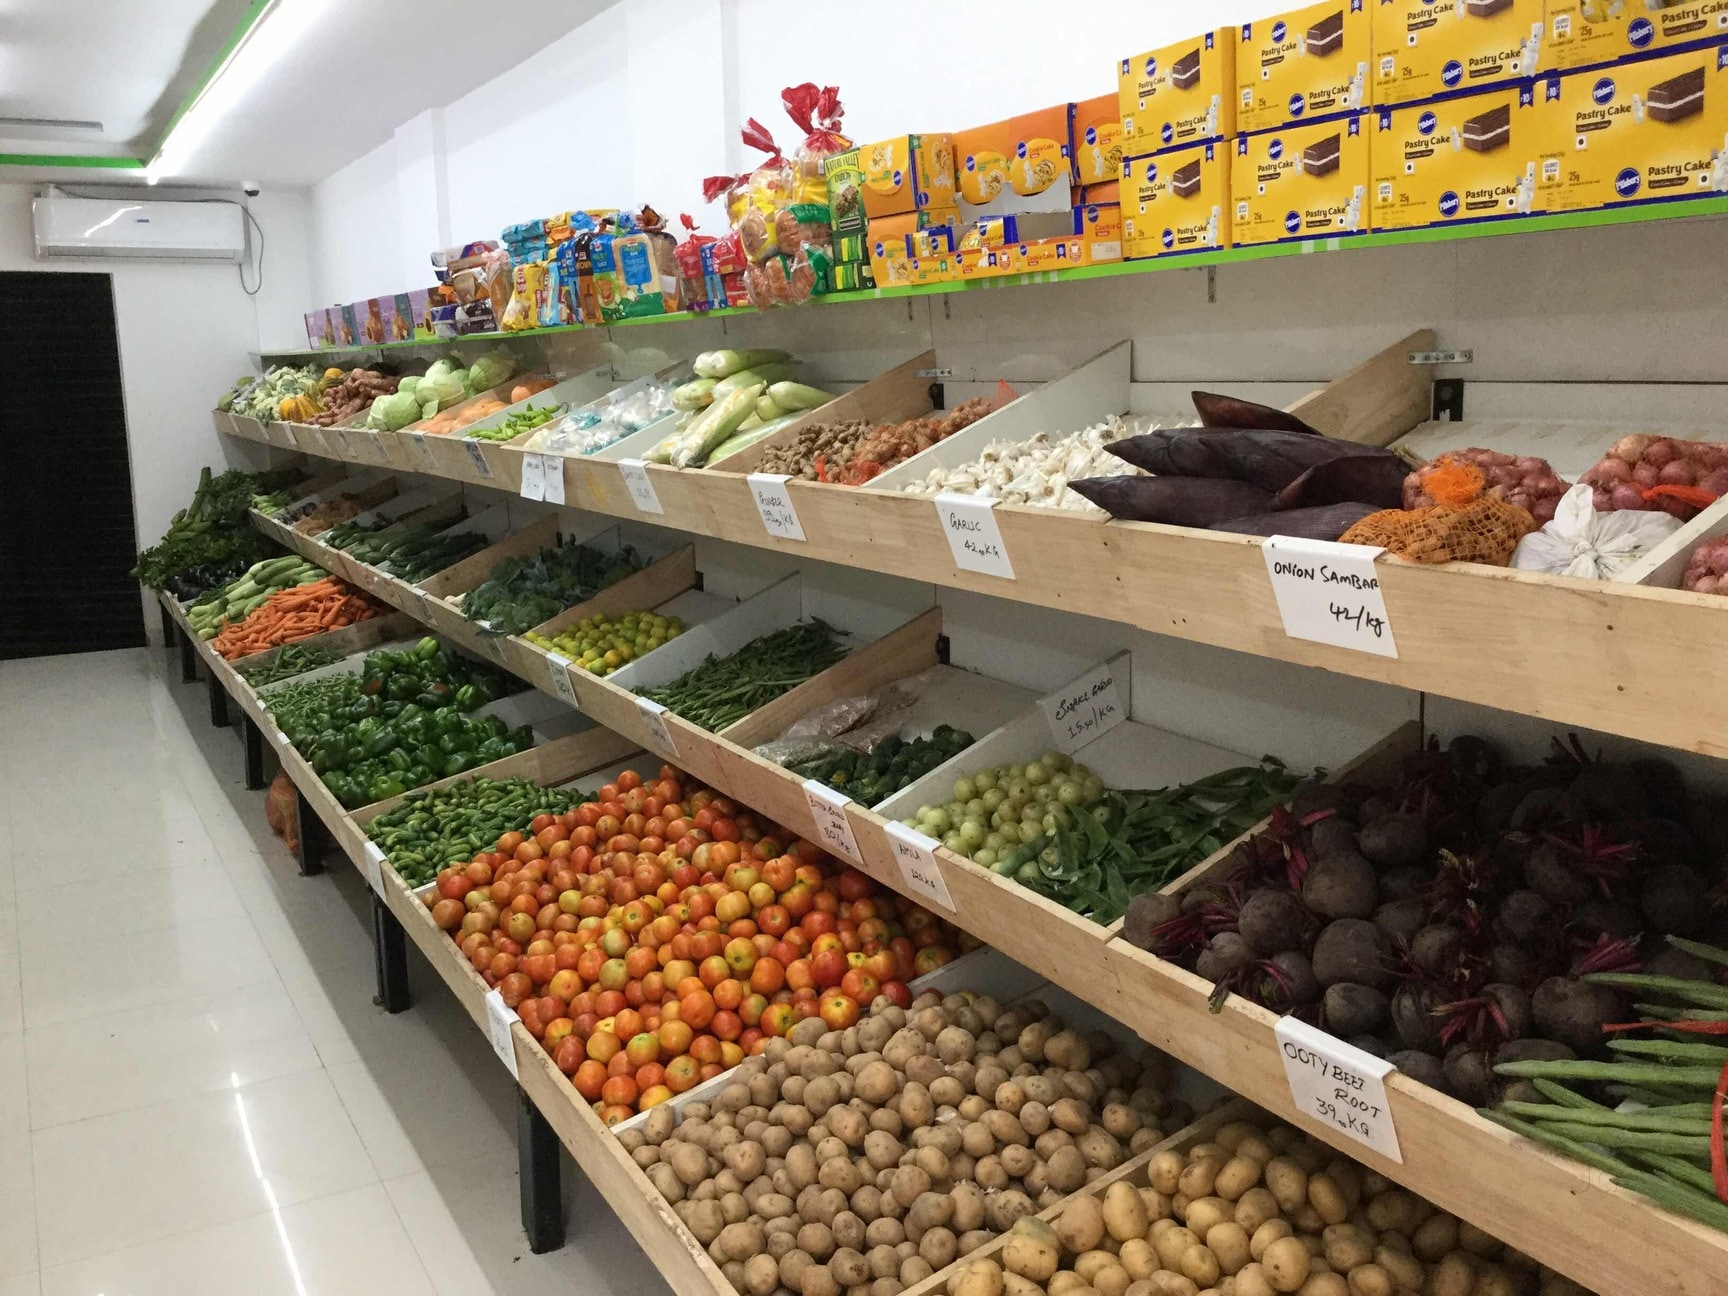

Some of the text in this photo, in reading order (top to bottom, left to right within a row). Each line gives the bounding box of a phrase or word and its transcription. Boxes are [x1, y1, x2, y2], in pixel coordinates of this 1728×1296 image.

[1407, 3, 1454, 20] Pastry Cake
[1661, 0, 1728, 24] Pastry Cake
[1261, 42, 1297, 57] Pastry Cake
[1468, 49, 1521, 67] Pastry Cake
[1309, 84, 1350, 100] Pastry Cake
[1576, 104, 1632, 121] Pastry Cake
[1404, 135, 1450, 150] Pastry Cake
[1257, 160, 1294, 172] Pastry Cake
[1648, 160, 1711, 176] Pastry Cake
[1466, 186, 1517, 199] Pastry Cake
[1305, 206, 1346, 218] Pastry Cake
[1320, 565, 1379, 590] SAMBAR
[1283, 1042, 1367, 1092] OOTY BEET
[1333, 1088, 1383, 1119] ROOT
